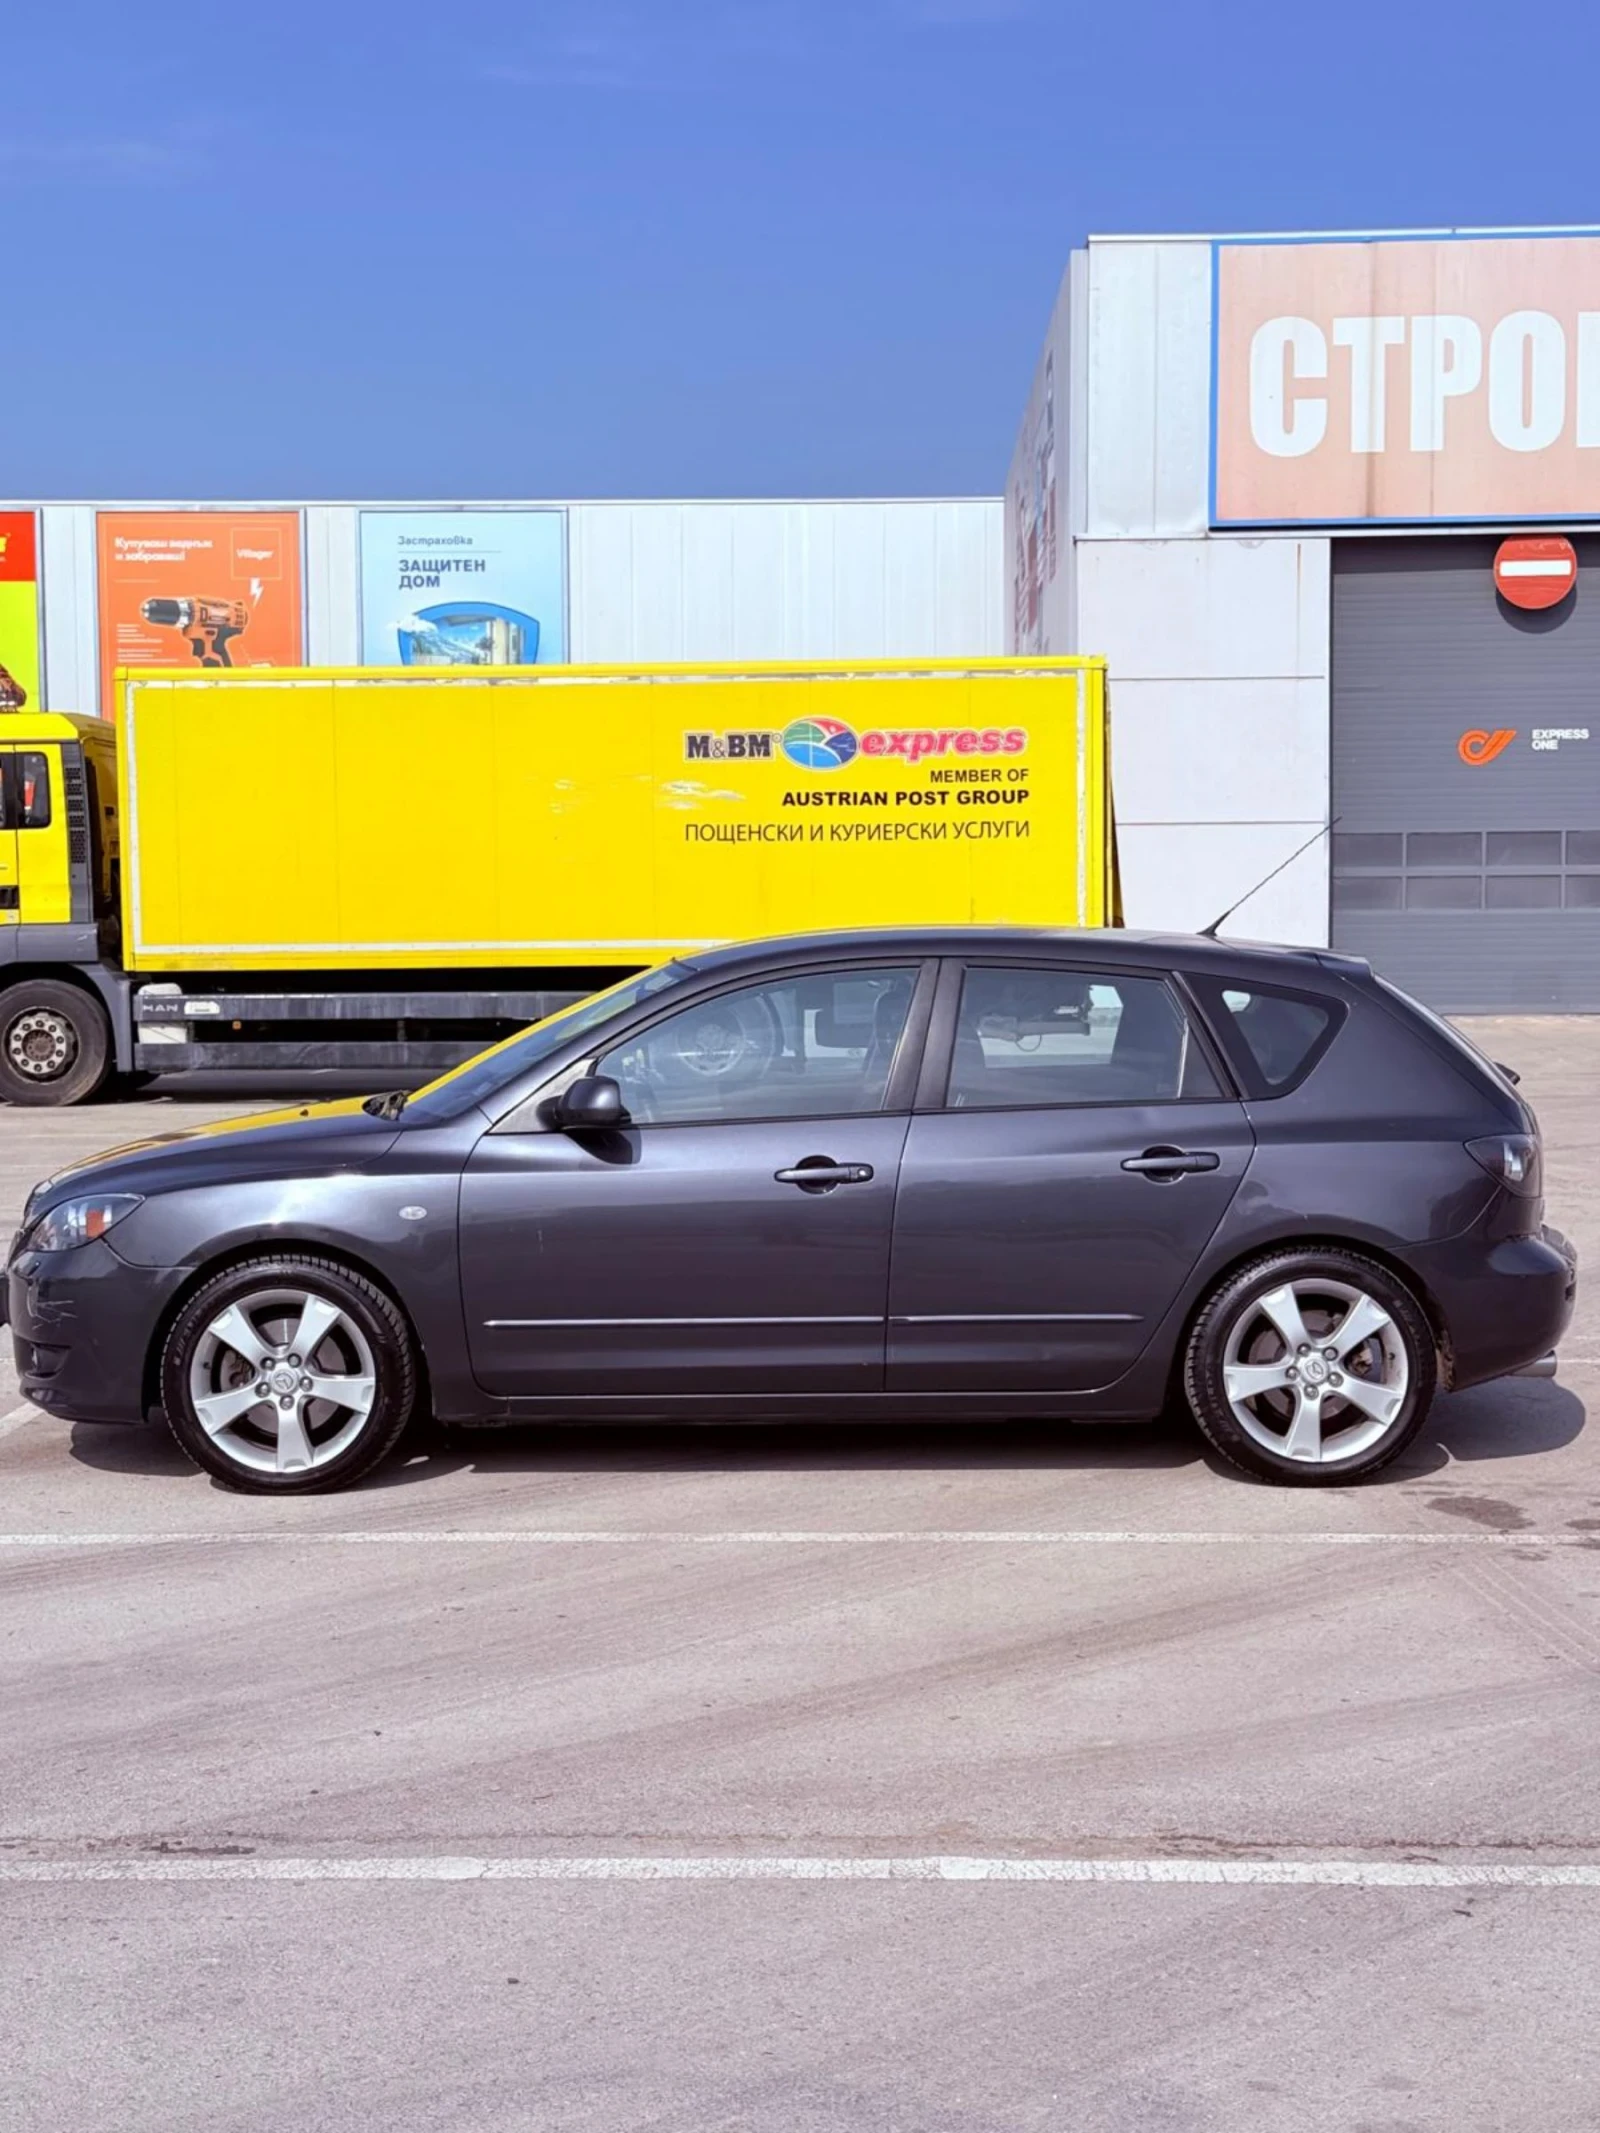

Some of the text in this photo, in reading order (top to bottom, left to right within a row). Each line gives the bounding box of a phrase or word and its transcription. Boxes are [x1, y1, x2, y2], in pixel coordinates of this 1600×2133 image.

[398, 535, 473, 546] Застраховка
[398, 559, 486, 574] ЗАЩИТЕН
[398, 575, 441, 590] ДОМ
[1531, 728, 1589, 739] EXPRESS
[861, 730, 1025, 762] express
[1531, 740, 1558, 750] ONE
[930, 768, 1029, 783] MEMBER OF
[782, 789, 1029, 806] AUSTRIAN POST GROUP
[685, 820, 1029, 844] ПОЩЕНСКИ И КУРИЕРСКИ УСЛУГИ
[143, 1004, 178, 1012] MAN
